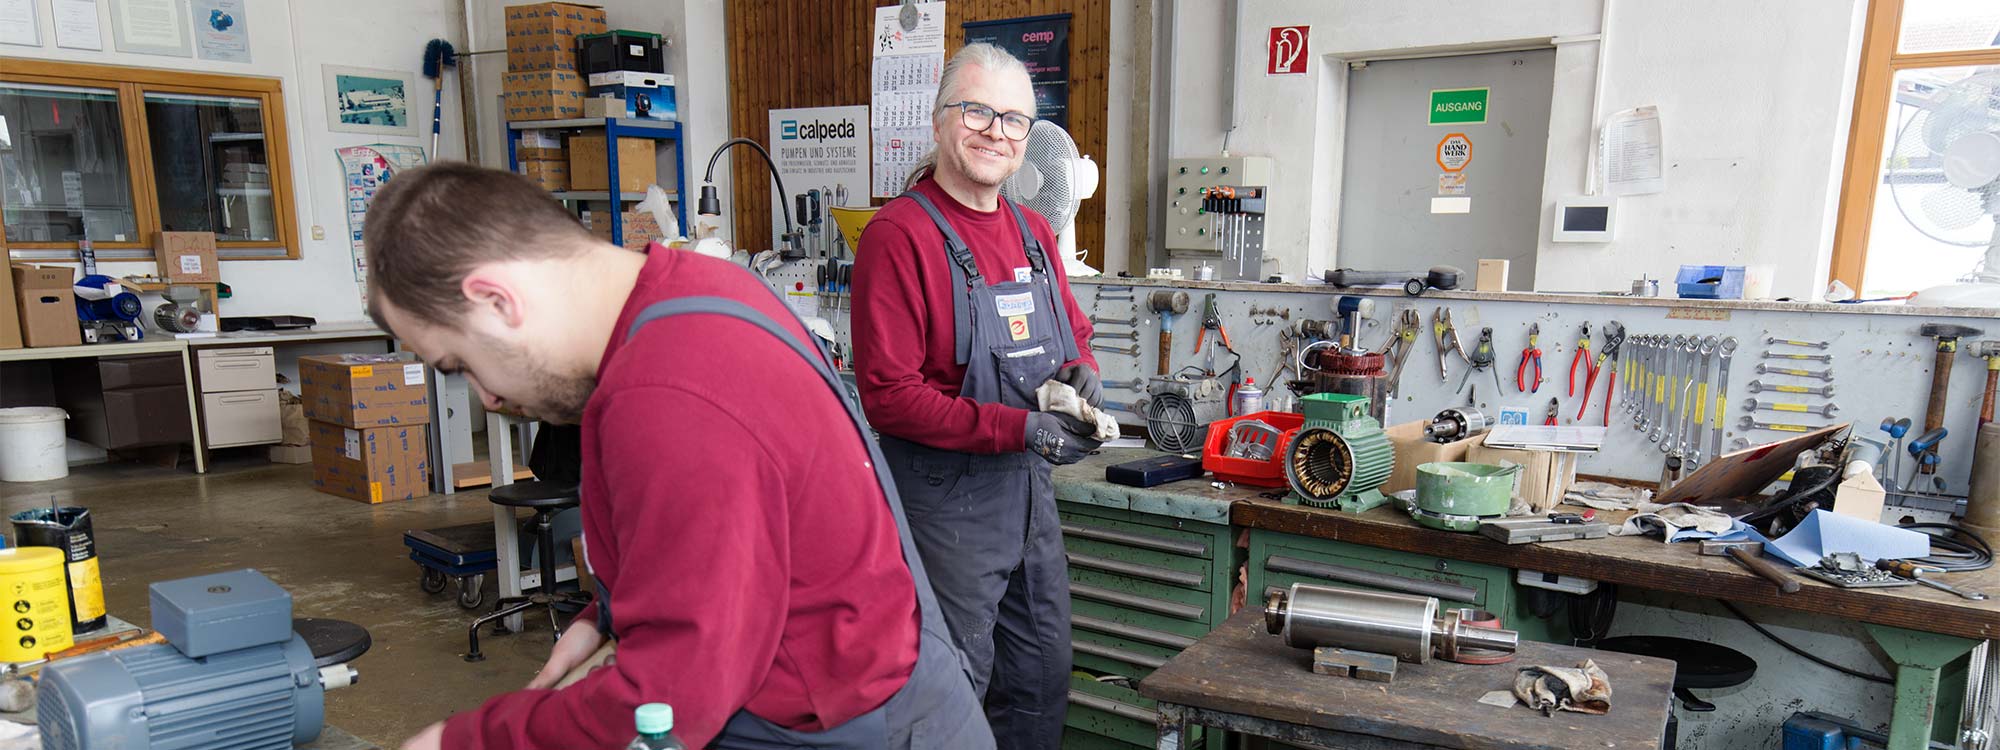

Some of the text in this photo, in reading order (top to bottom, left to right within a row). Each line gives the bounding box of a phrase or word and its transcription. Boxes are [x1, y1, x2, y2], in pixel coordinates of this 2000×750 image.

[1022, 31, 1054, 43] cemp
[1435, 101, 1482, 113] AUSGANG
[800, 118, 855, 143] calpeda
[781, 146, 856, 158] PUMPEN UND SYSTEME
